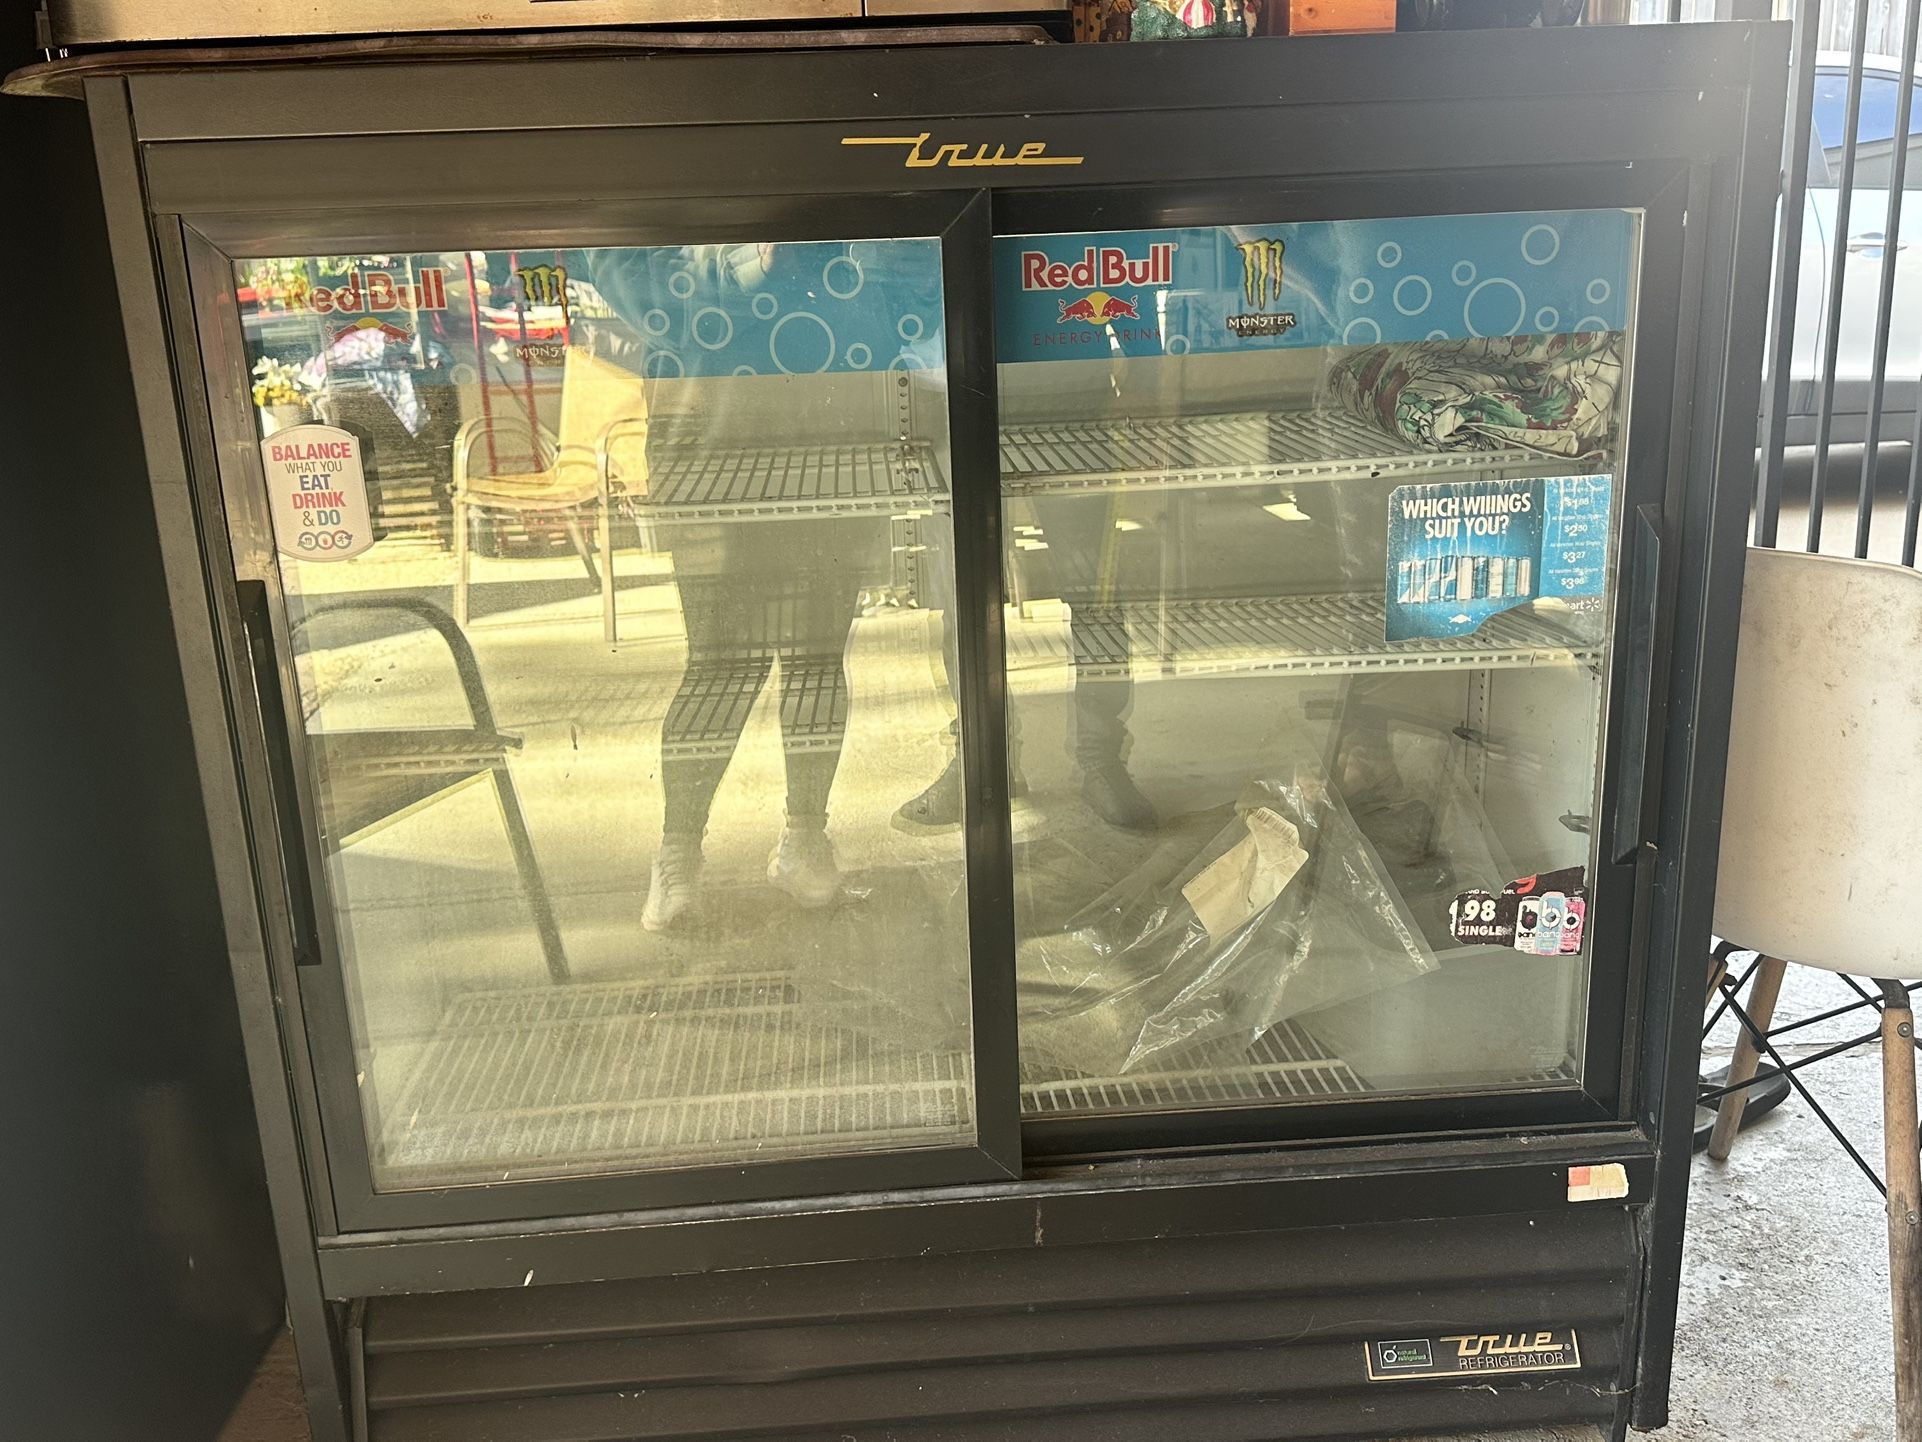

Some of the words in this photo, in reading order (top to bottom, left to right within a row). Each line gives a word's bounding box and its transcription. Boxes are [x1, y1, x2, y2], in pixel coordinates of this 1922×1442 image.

[1228, 315, 1295, 329] MONSTER
[1033, 331, 1101, 346] ENERGY
[271, 442, 352, 462] BALANCE
[285, 461, 317, 474] WHAT
[320, 460, 343, 473] YOU
[292, 491, 346, 509] DRINK
[1402, 496, 1460, 519] WHICH
[302, 510, 315, 527] &
[317, 509, 341, 526] DO
[1424, 518, 1461, 539] SUIT
[1465, 515, 1510, 536] YOU?
[1459, 1352, 1566, 1370] REFRIGERATOR
